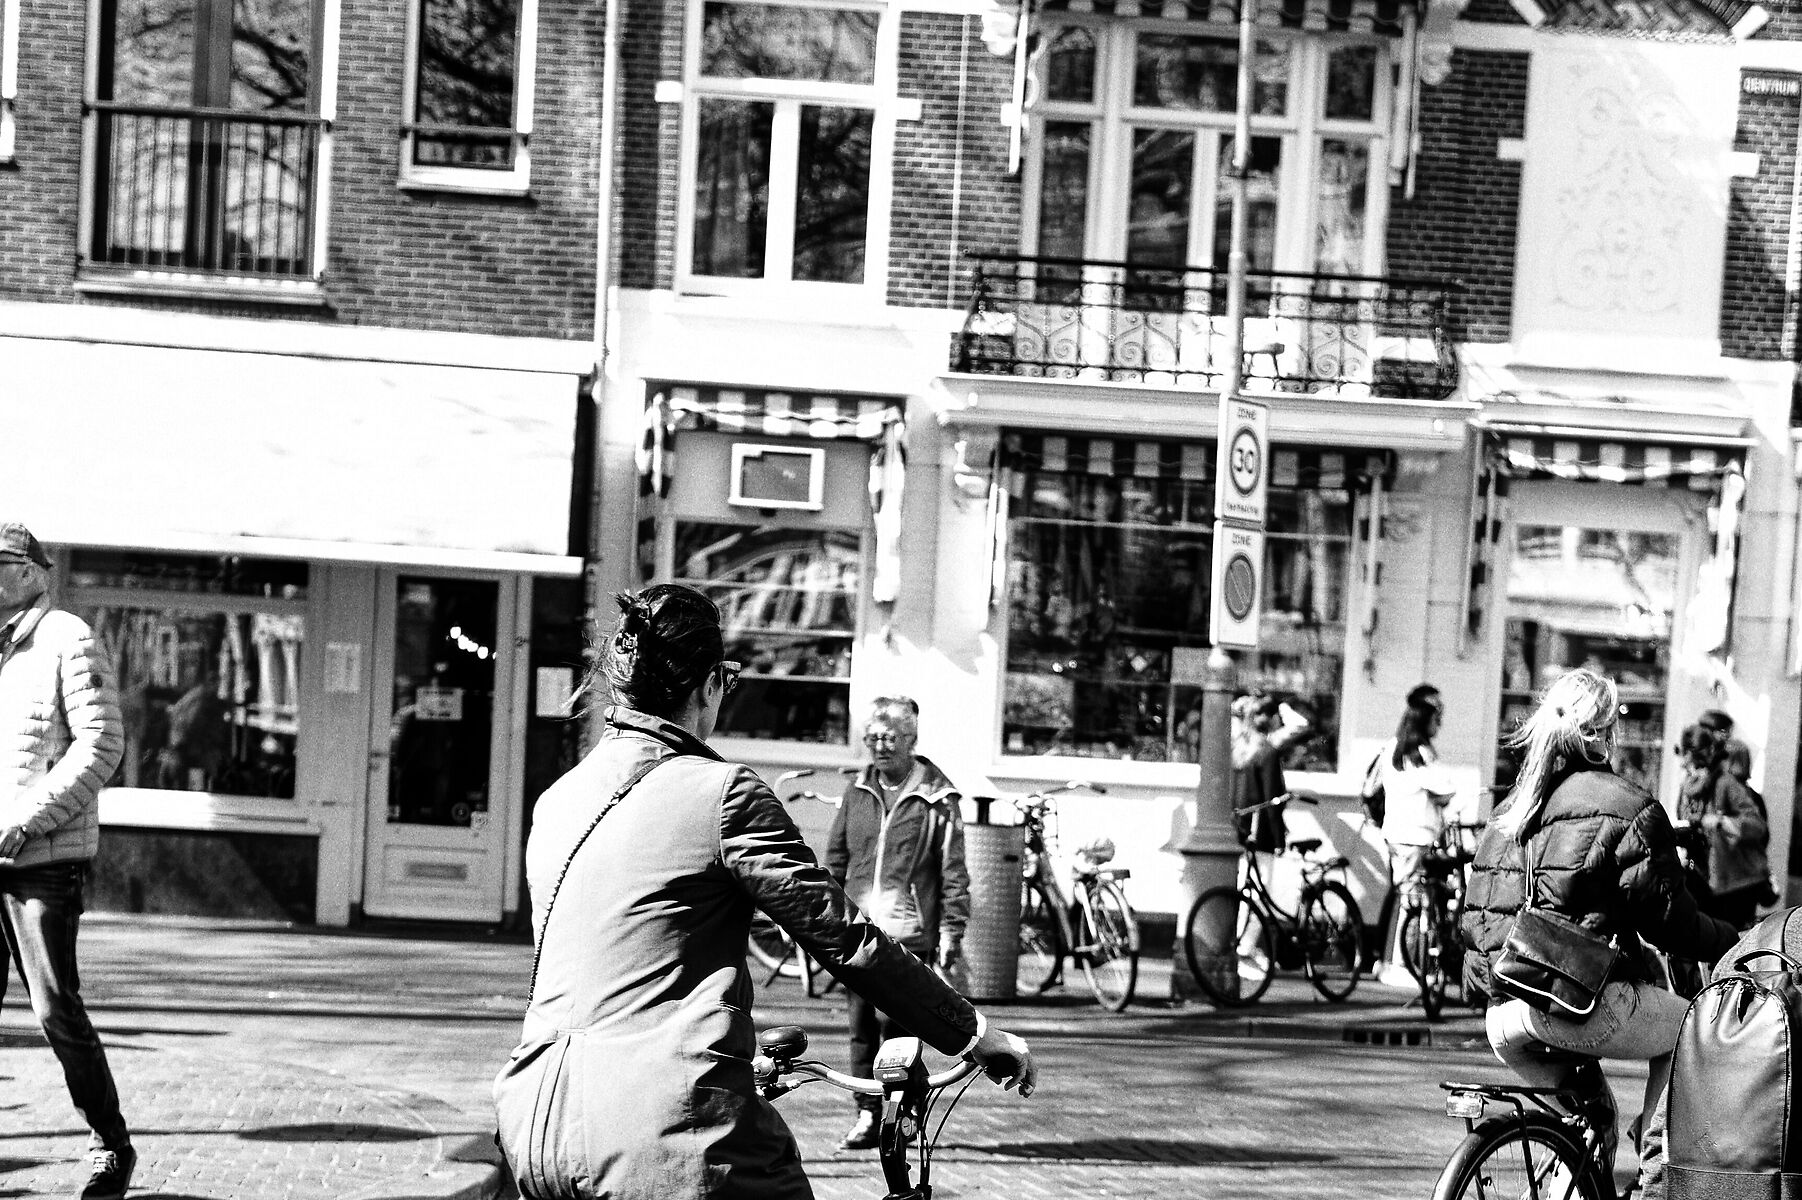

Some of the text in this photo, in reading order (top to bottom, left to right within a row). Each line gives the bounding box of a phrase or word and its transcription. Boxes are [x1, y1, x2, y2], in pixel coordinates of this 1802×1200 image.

[1237, 407, 1257, 420] ZONE
[1234, 448, 1254, 474] 30
[1232, 532, 1252, 546] ZONE
